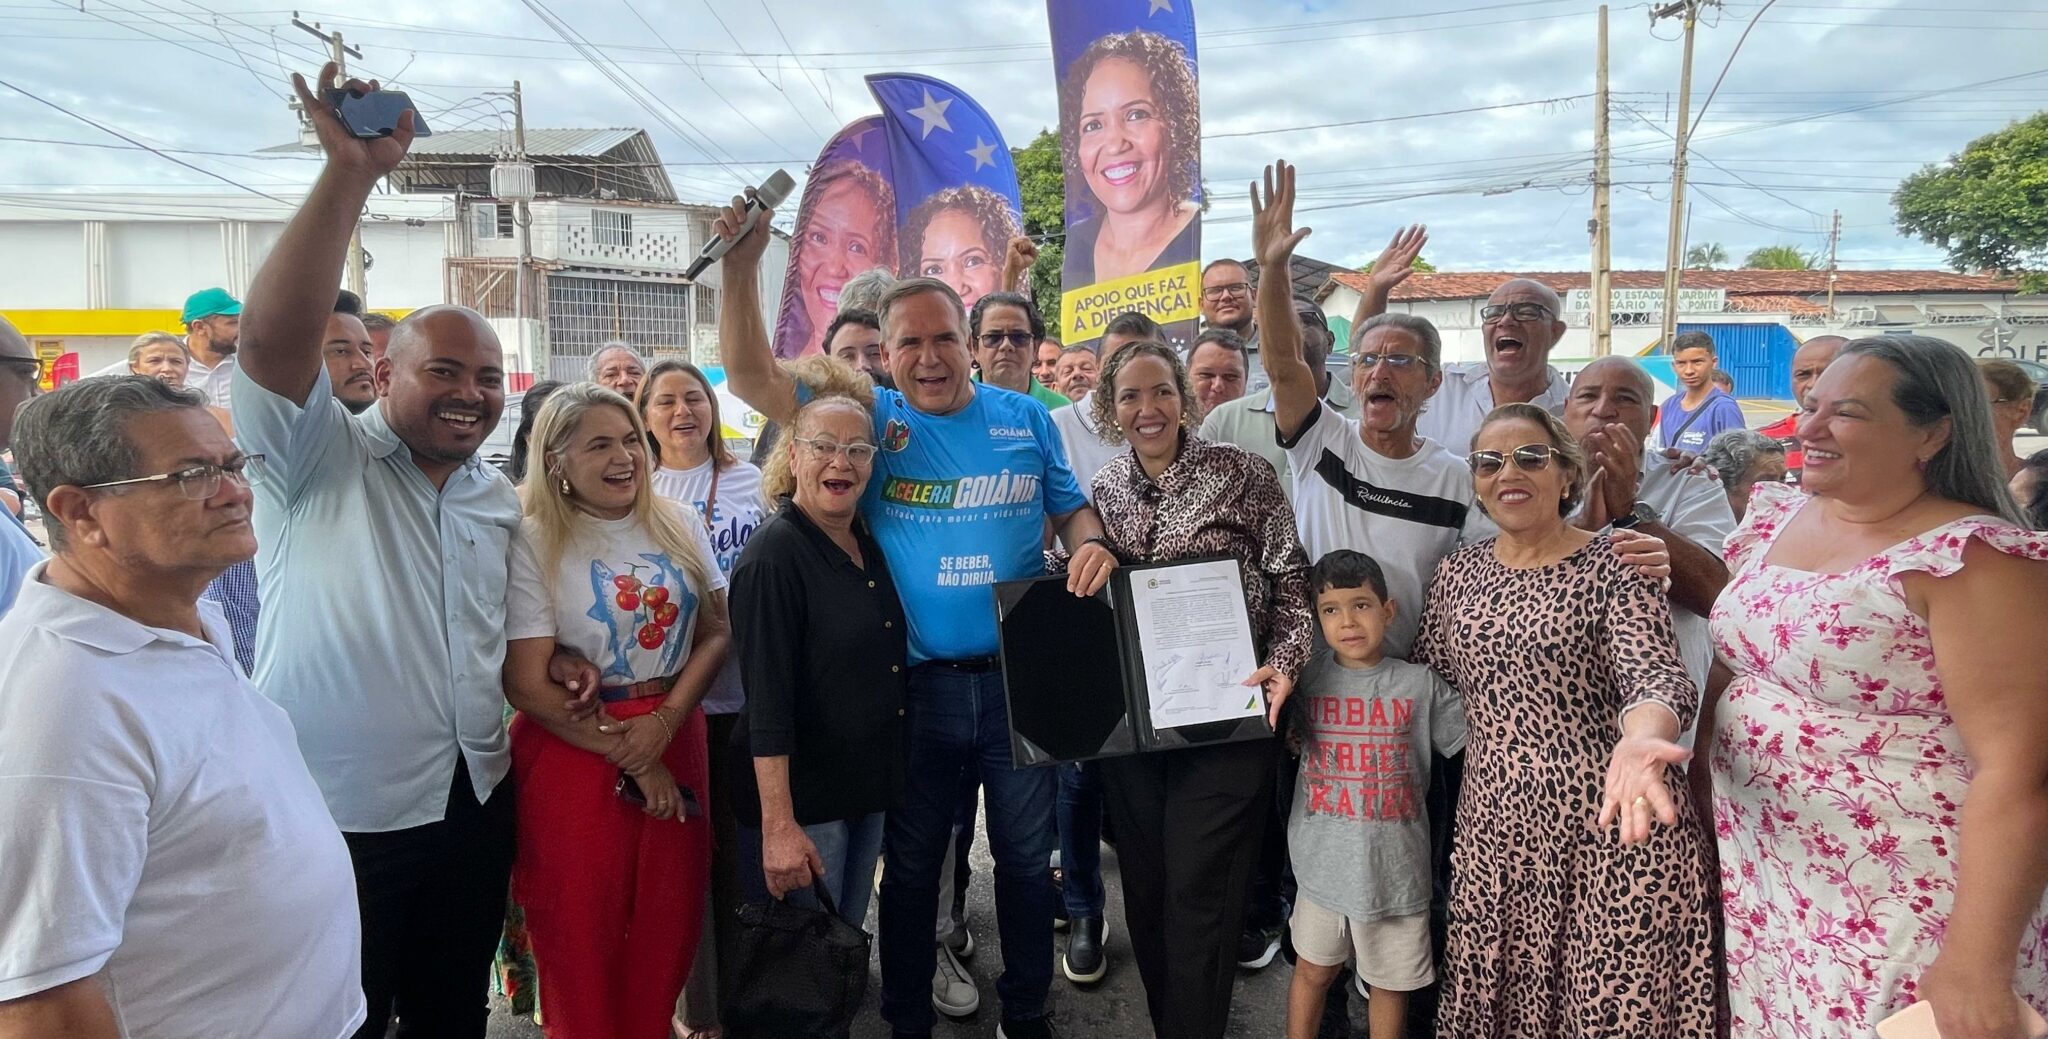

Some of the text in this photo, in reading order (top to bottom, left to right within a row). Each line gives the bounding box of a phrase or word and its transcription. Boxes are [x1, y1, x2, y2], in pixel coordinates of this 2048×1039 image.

[1075, 276, 1187, 313] APOIO QUE FAZ
[1625, 290, 1664, 300] ESTADU
[1679, 290, 1718, 300] JARDIM
[1575, 300, 1646, 310] BAEÁRIO
[1688, 300, 1719, 310] PONTE
[1074, 316, 1087, 332] A
[886, 468, 1037, 509] ACELERA GOIÂNIA
[919, 514, 942, 524] para
[947, 513, 978, 523] morar
[993, 508, 1013, 519] vida
[940, 554, 993, 571] SE BEBER,
[937, 570, 998, 586] NÃO DIRIJA.
[1306, 696, 1415, 728] URBAN
